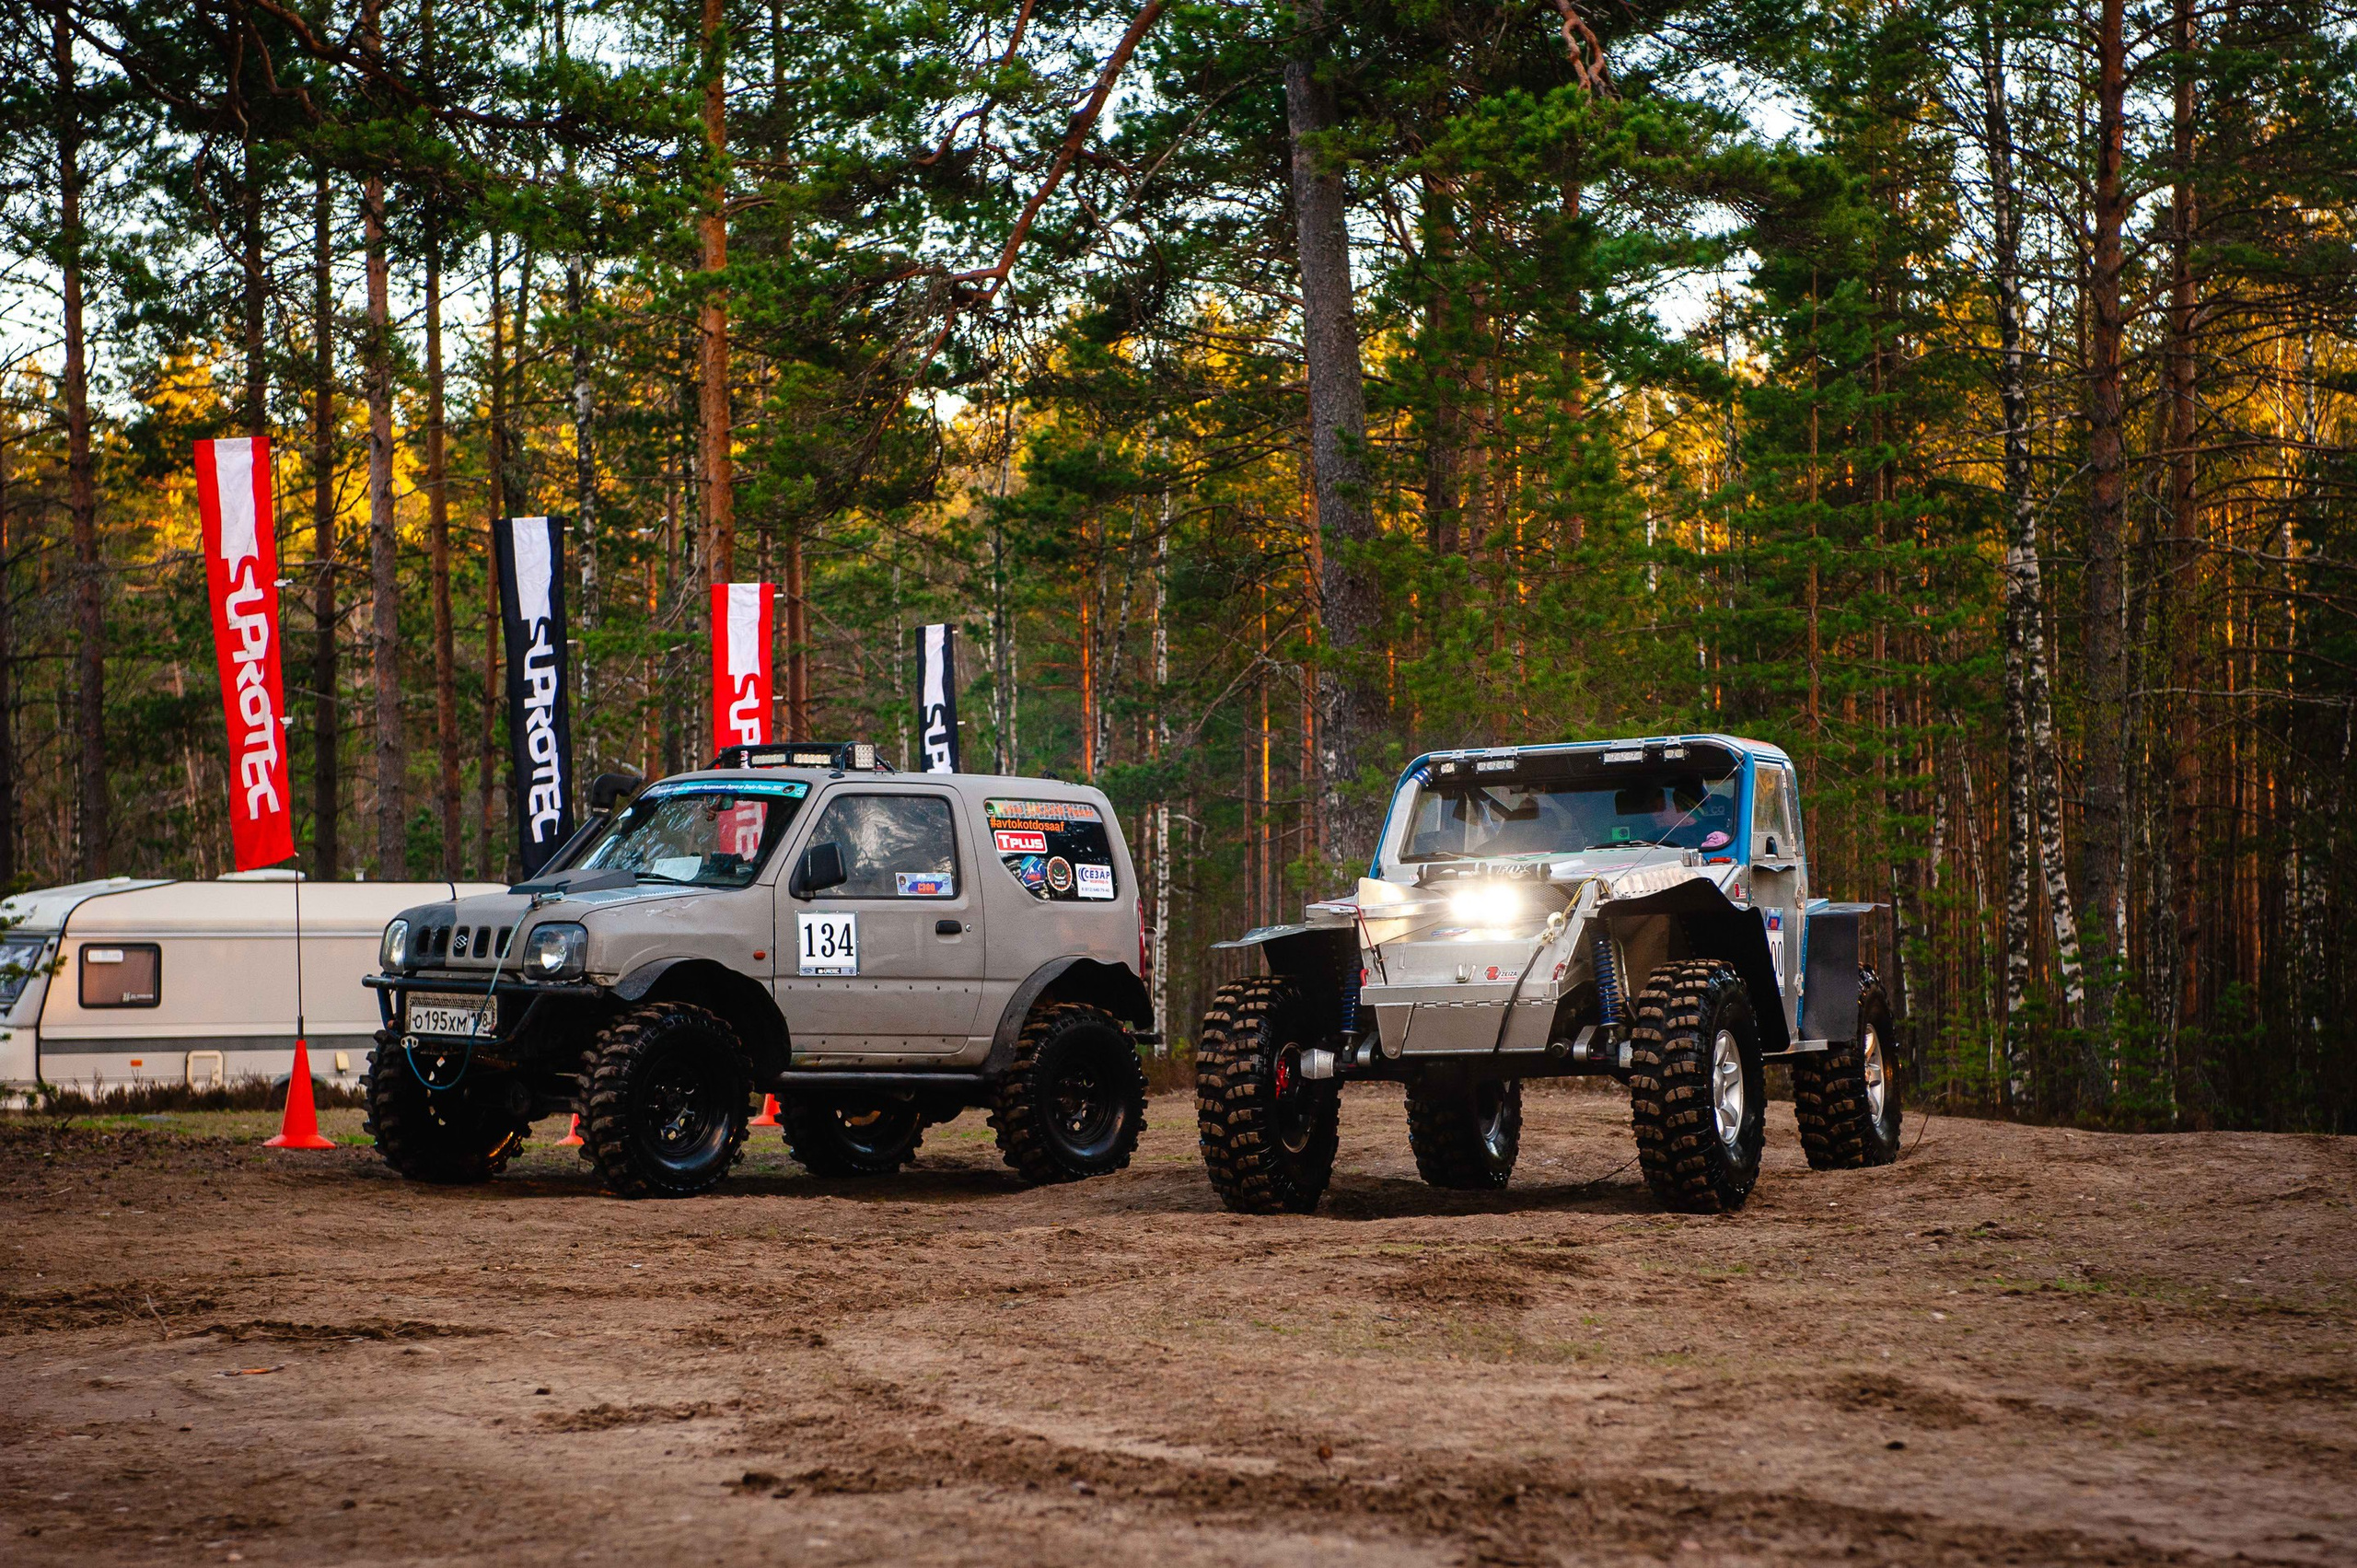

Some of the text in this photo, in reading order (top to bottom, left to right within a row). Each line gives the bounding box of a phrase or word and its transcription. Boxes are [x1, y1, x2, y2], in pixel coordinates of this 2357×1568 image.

[223, 539, 280, 820] SUPROTEC
[522, 603, 562, 843] SUPROTEC
[990, 817, 1065, 831] #avtokotdosaaf
[998, 834, 1044, 849] TPLUS
[804, 923, 853, 958] 134
